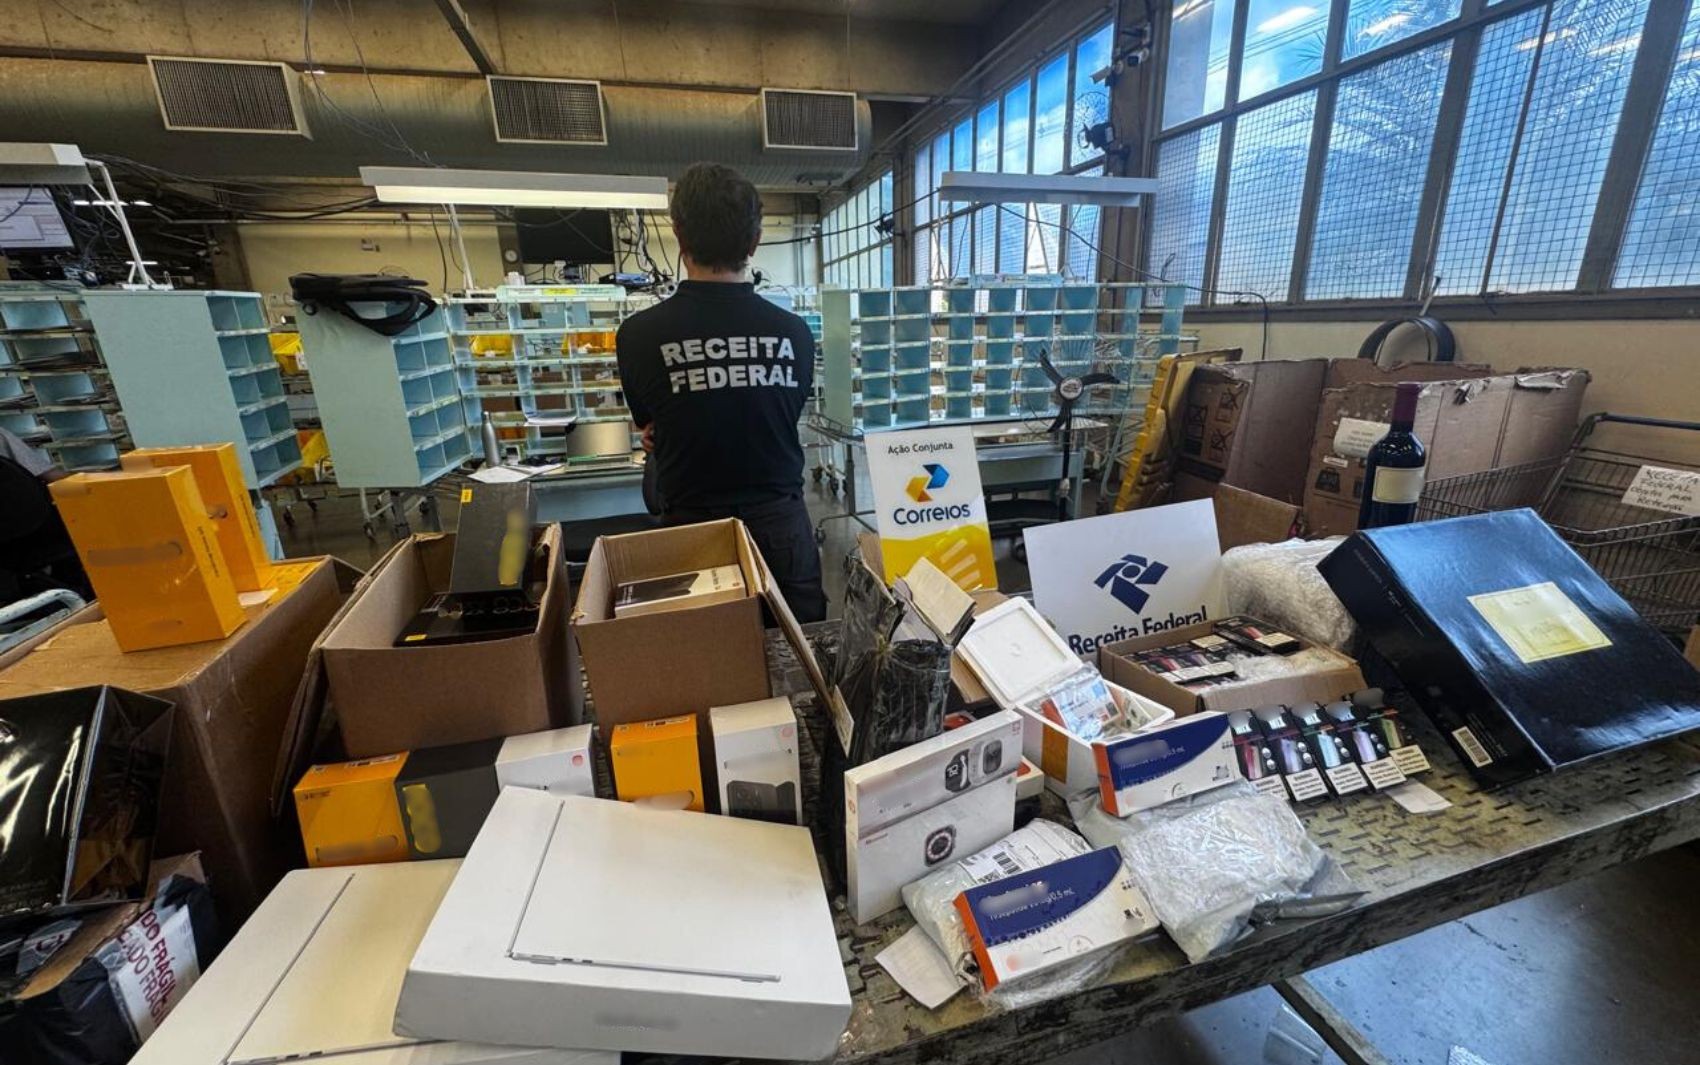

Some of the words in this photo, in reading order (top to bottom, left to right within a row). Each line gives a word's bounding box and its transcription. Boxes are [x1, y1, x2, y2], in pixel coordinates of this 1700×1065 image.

[660, 336, 795, 367] RECEITA
[669, 364, 799, 394] FEDERAL
[887, 444, 911, 456] Ação
[912, 442, 954, 453] Conjunta
[893, 504, 971, 525] Correios
